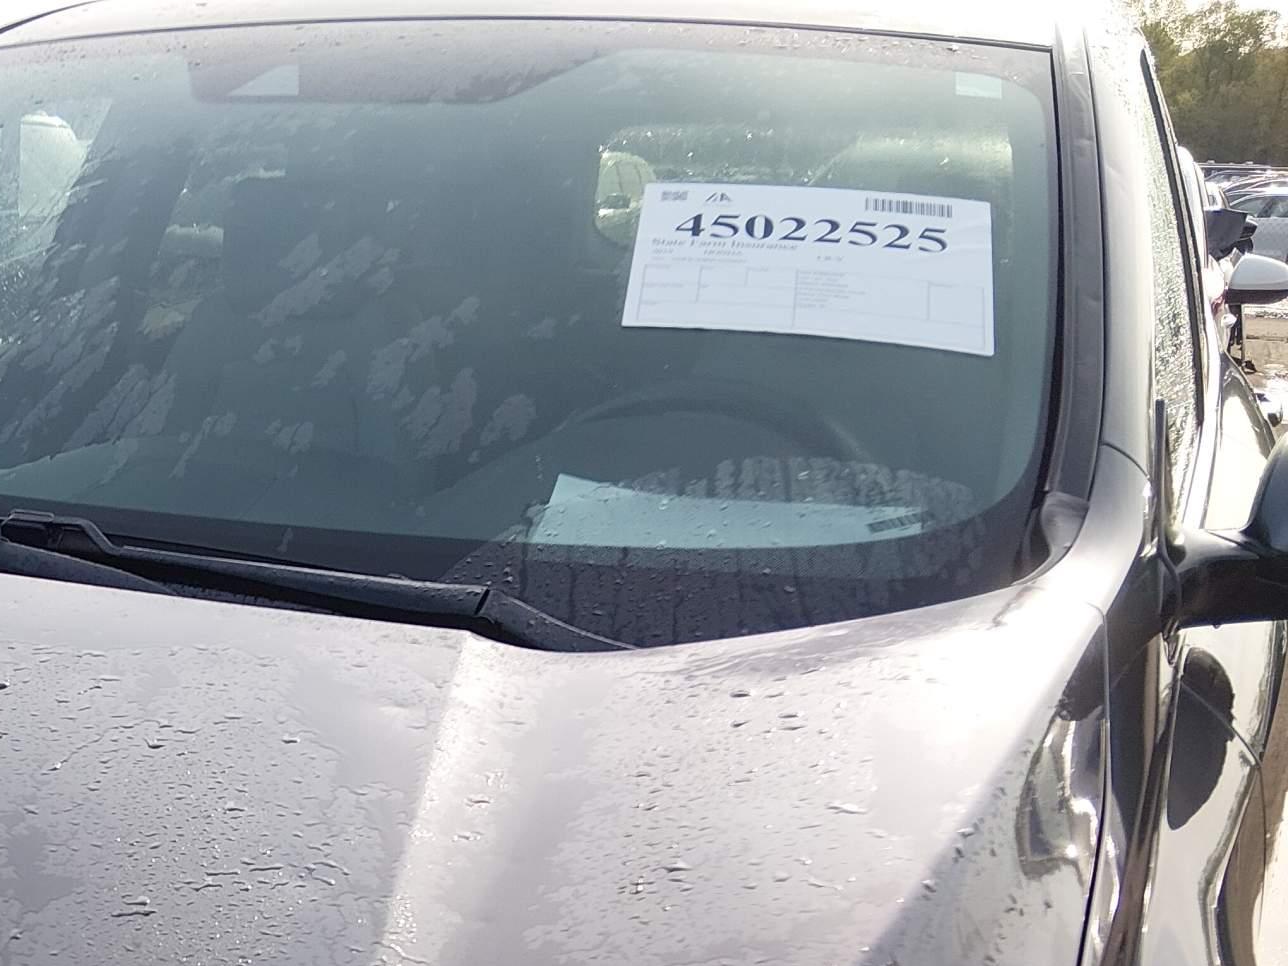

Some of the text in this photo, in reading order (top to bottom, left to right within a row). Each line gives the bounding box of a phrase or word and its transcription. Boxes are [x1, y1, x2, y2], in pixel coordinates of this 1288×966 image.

[652, 238, 687, 247] State
[690, 239, 727, 249] Farm
[674, 212, 948, 254] 45022525
